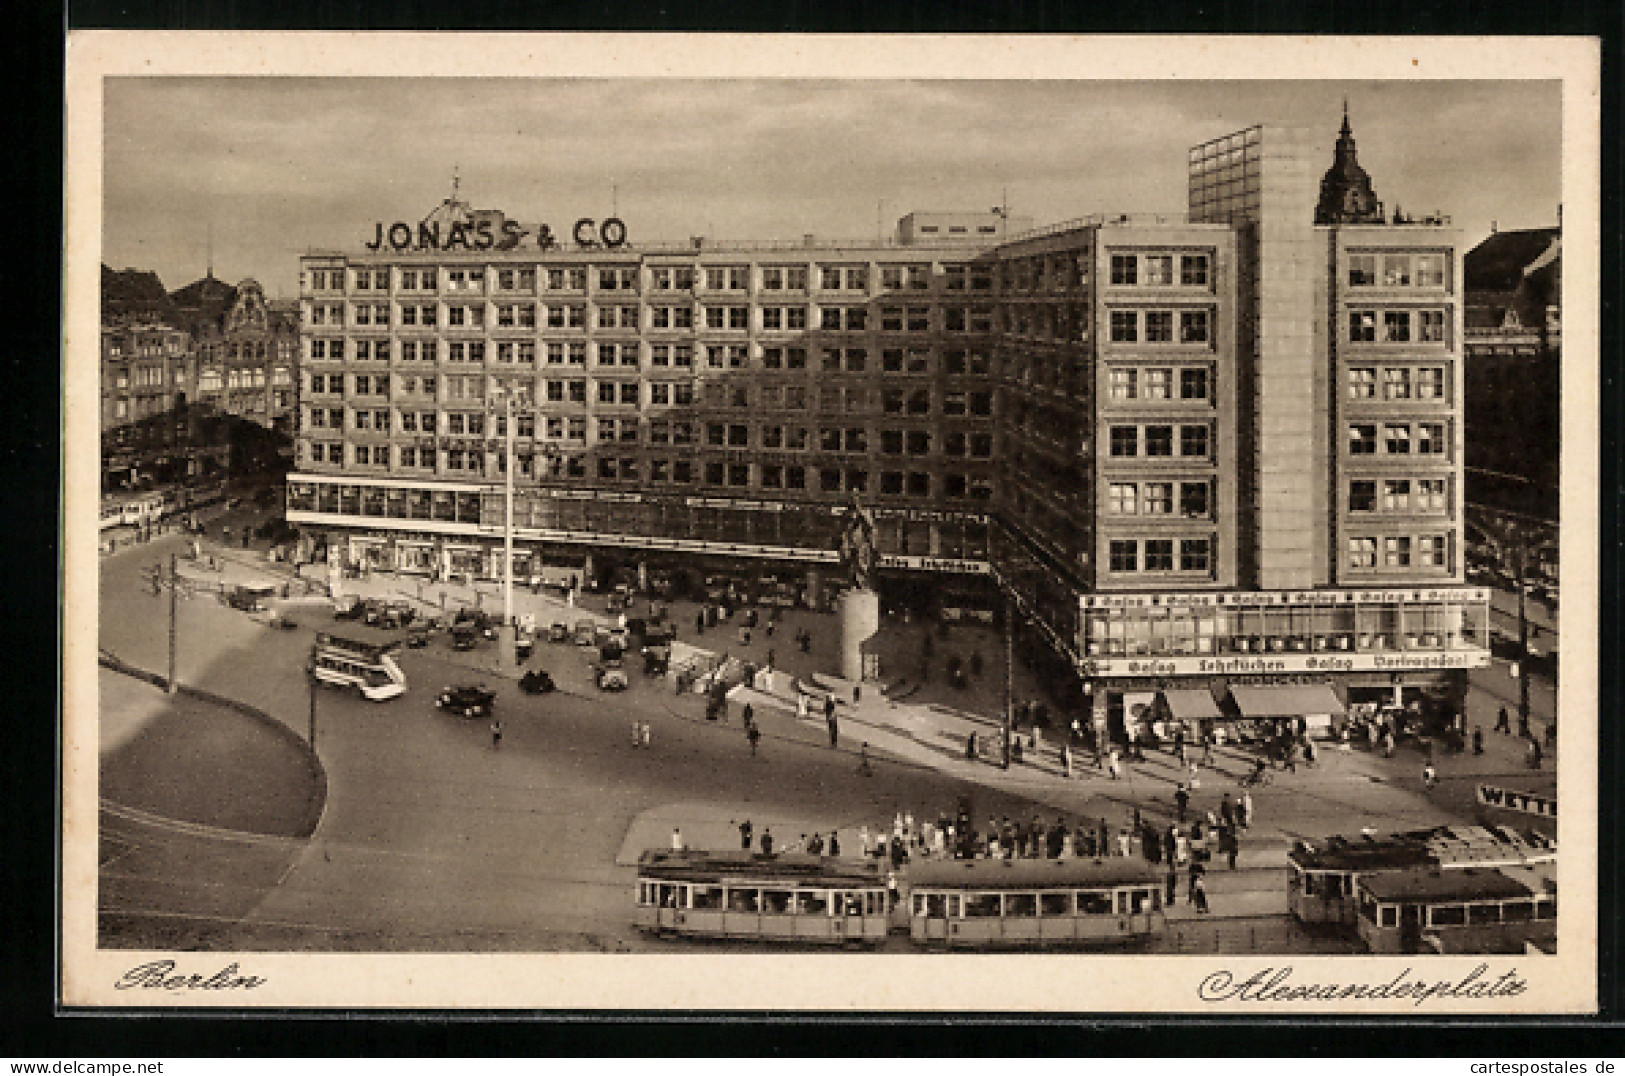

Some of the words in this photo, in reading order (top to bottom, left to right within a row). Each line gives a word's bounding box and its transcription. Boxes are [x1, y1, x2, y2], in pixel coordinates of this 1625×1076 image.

[366, 220, 522, 250] JONASS
[537, 223, 556, 250] &
[114, 960, 267, 991] Berlin
[1197, 962, 1527, 1006] Alexanderplatz
